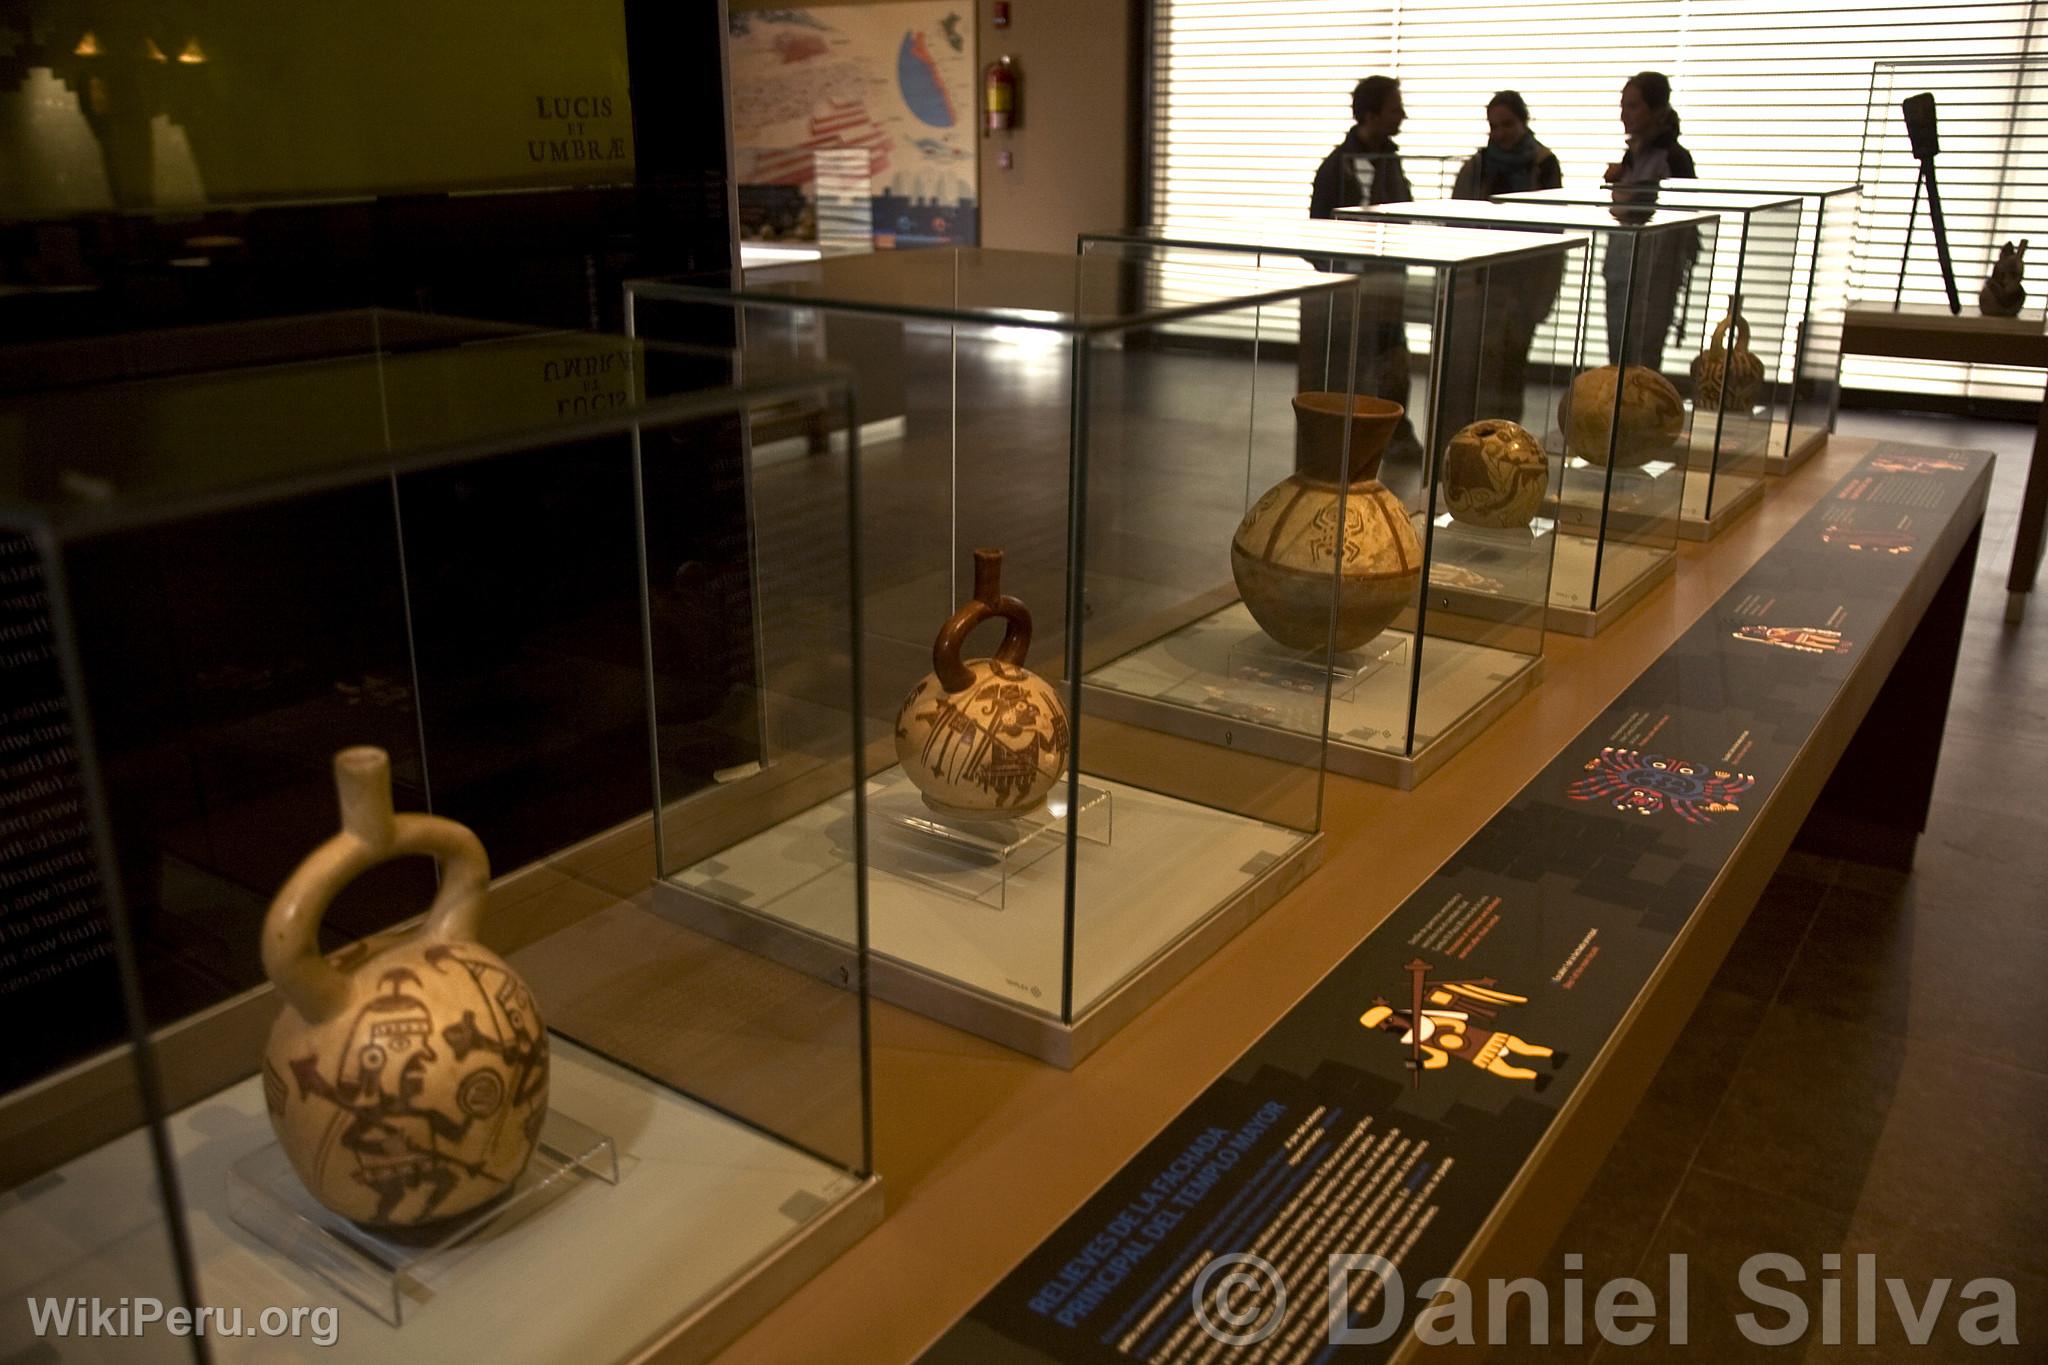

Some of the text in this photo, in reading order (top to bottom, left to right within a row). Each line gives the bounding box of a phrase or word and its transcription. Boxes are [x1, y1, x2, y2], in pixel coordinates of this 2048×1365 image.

[536, 96, 613, 119] LUCIS
[1028, 1126, 1228, 1315] RELIEVES DE LA FACHADA
[1055, 1099, 1288, 1329] PRINCIPAL DEL TEMPLO MAYOR
